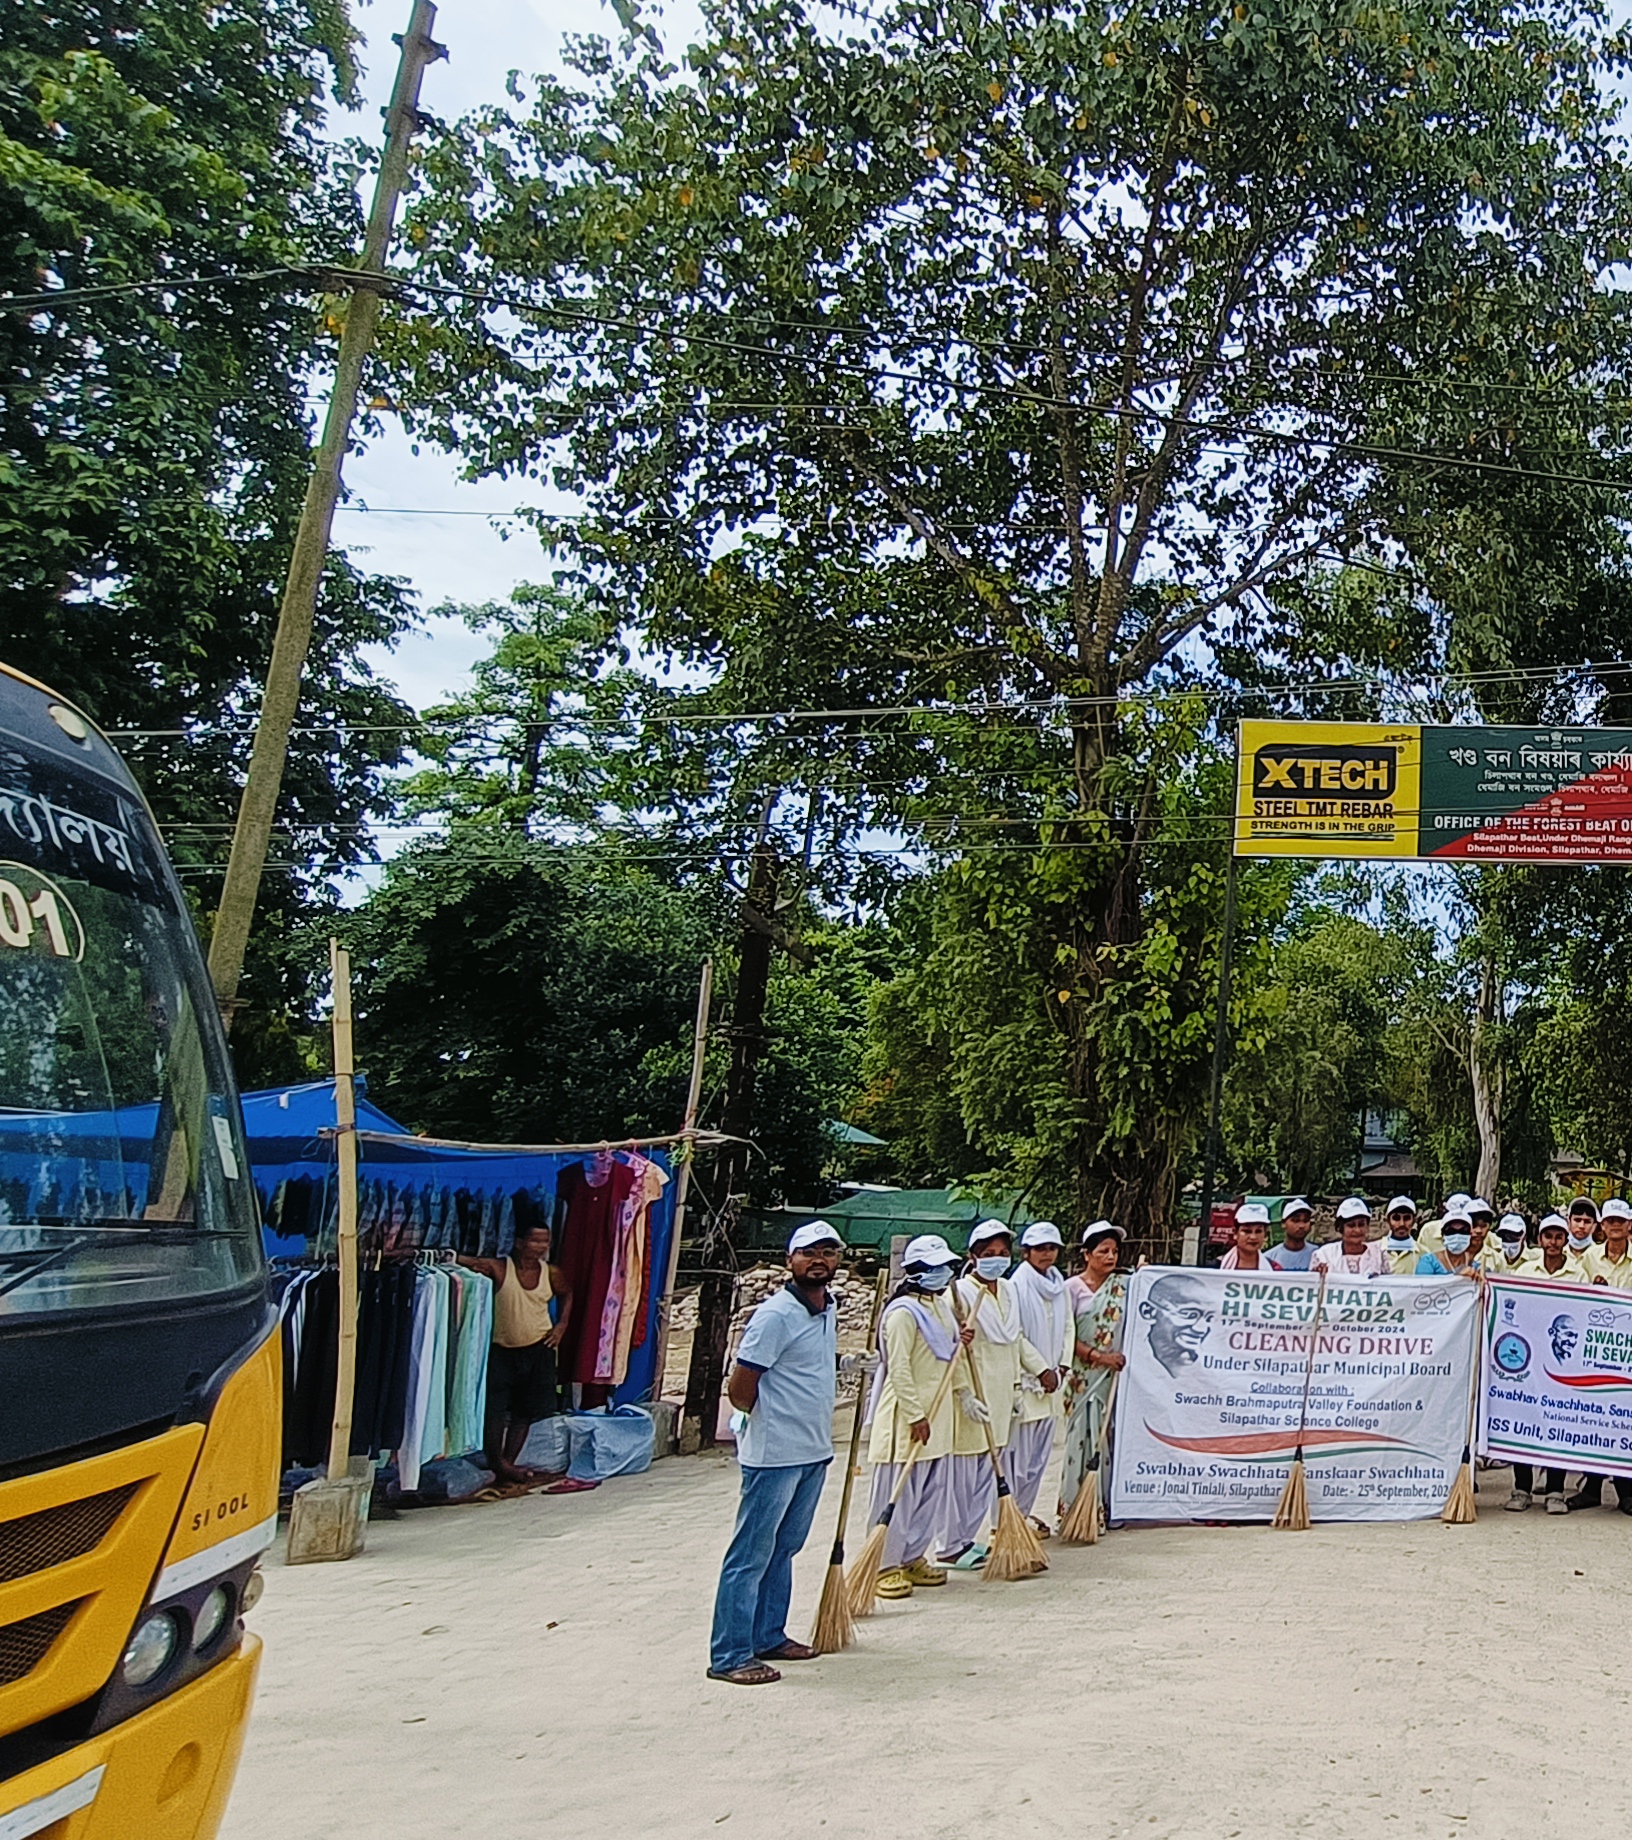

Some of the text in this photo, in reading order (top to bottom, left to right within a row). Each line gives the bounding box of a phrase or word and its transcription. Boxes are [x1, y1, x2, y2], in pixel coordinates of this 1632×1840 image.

[1484, 749, 1512, 768] বন
[1258, 757, 1388, 791] XTECH
[1254, 801, 1394, 818] STEEL TMT REBAR
[1250, 821, 1395, 832] STRENGTH IS IN THE GRIP
[1434, 816, 1480, 829] OFFICE
[1484, 816, 1501, 830] OF
[1505, 818, 1530, 830] THE
[1534, 818, 1582, 831] FOREST
[1586, 819, 1618, 832] BEAT
[1467, 844, 1506, 854] Dhemaji
[1508, 845, 1550, 854] Division,
[1224, 1282, 1393, 1307] SWACHHATA
[1221, 1300, 1406, 1324] HI SEVA 2024
[1244, 1320, 1303, 1332] September
[1332, 1324, 1374, 1334] October
[1378, 1326, 1406, 1334] 2024
[1359, 1337, 1433, 1356] DRIVE
[1583, 1344, 1598, 1359] HI
[1204, 1356, 1250, 1371] Under
[1334, 1361, 1406, 1378] Municipal
[1410, 1362, 1452, 1376] Board
[1174, 1392, 1424, 1412] Swachh Brahmaputra Valley Foundation &
[1488, 1386, 1538, 1405] Swabhav
[1540, 1395, 1606, 1416] Swachhata,
[1220, 1412, 1380, 1430] Silapathar Scence College
[1544, 1410, 1578, 1424] National
[1580, 1416, 1610, 1428] Service
[1514, 1422, 1543, 1440] Unit,
[1548, 1428, 1616, 1448] Silapathar
[1136, 1461, 1445, 1480] Swabhav Swachhata anskaar Swachhata
[1124, 1480, 1156, 1494] Venue
[1228, 1483, 1282, 1500] Silapathar
[1376, 1484, 1430, 1500] September,
[1432, 1485, 1450, 1498] 202
